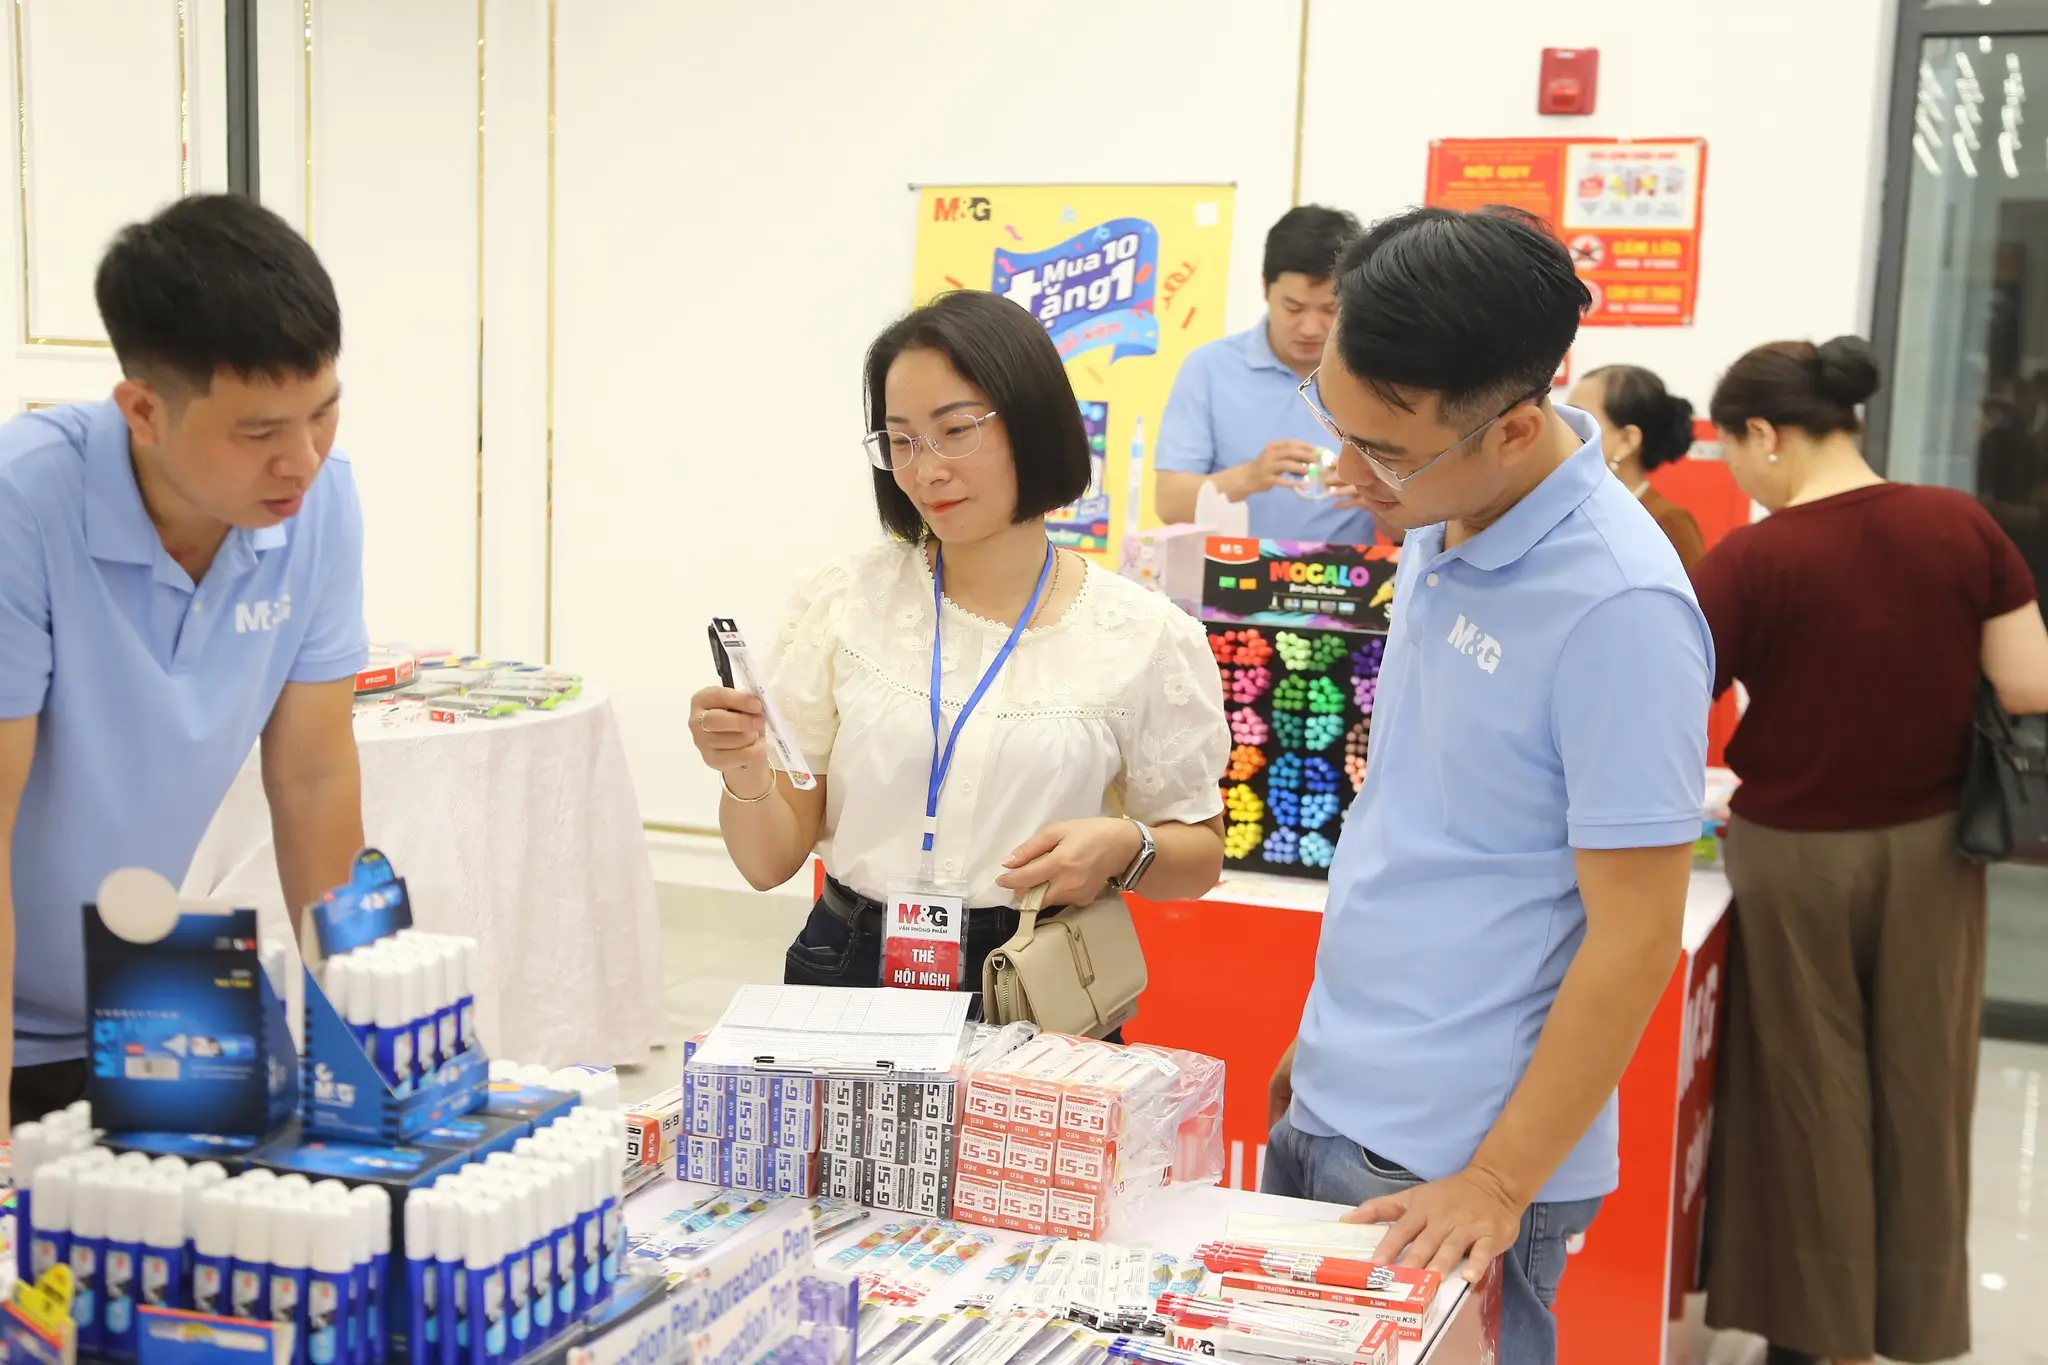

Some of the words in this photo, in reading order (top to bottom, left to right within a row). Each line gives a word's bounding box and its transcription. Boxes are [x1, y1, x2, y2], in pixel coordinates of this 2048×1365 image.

[934, 197, 991, 222] M&G
[1042, 253, 1101, 286] Mua
[1102, 233, 1139, 265] 10
[1269, 561, 1370, 587] MOCALO
[1447, 614, 1502, 674] M&G
[898, 903, 948, 927] M&G
[912, 946, 935, 963] THẺ
[894, 968, 915, 986] HỘI
[920, 972, 950, 990] NGHỊ
[970, 1117, 983, 1125] RED
[1015, 1125, 1029, 1133] RED
[1065, 1131, 1079, 1139] RED
[963, 1163, 977, 1171] RED
[1010, 1172, 1024, 1180] RED
[1061, 1178, 1075, 1186] RED
[960, 1210, 973, 1218] RED
[1005, 1219, 1018, 1227] RED
[1054, 1226, 1068, 1234] RED
[783, 1226, 809, 1269] Pen
[1257, 1284, 1295, 1295] RETRACTABLE
[1375, 1313, 1401, 1321] OFFICE
[1402, 1316, 1417, 1324] K35
[1177, 1336, 1215, 1357] M&G
